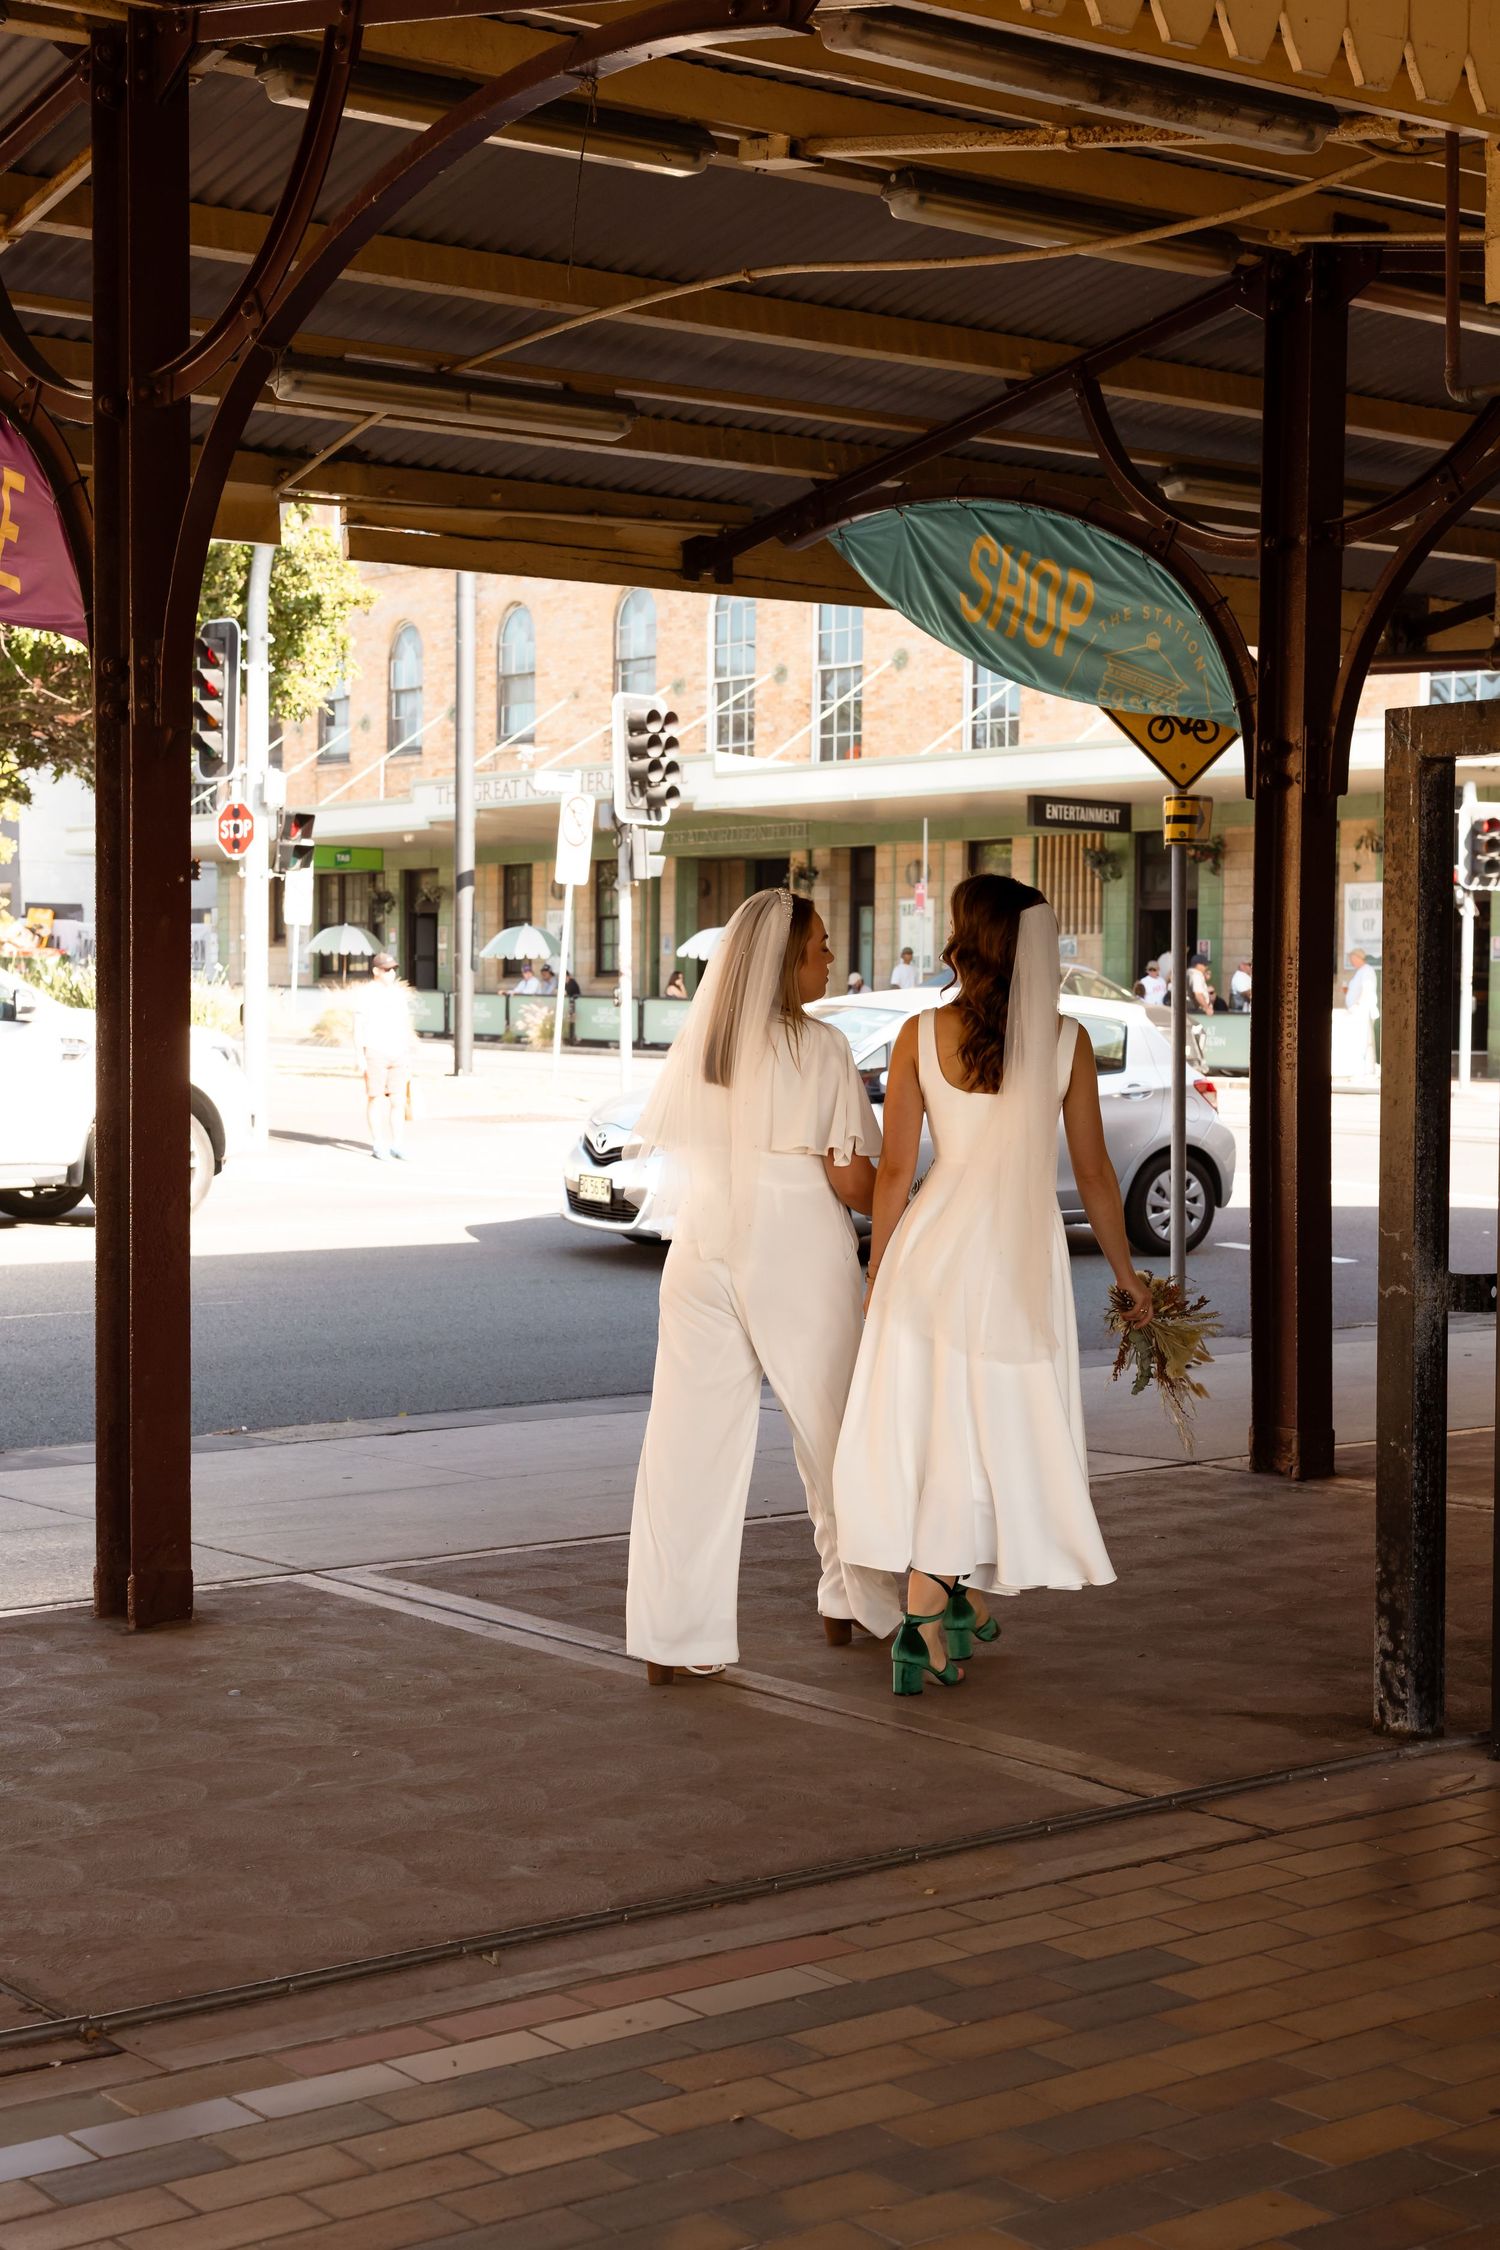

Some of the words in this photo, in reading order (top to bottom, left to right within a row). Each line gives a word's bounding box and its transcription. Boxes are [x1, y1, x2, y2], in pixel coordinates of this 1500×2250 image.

[959, 533, 1095, 657] SHOP
[1099, 607, 1132, 634] THE
[1142, 605, 1207, 674] STATION
[474, 780, 521, 802] GREAT
[1045, 803, 1121, 825] ENTERTAINMENT
[220, 819, 252, 839] STOP
